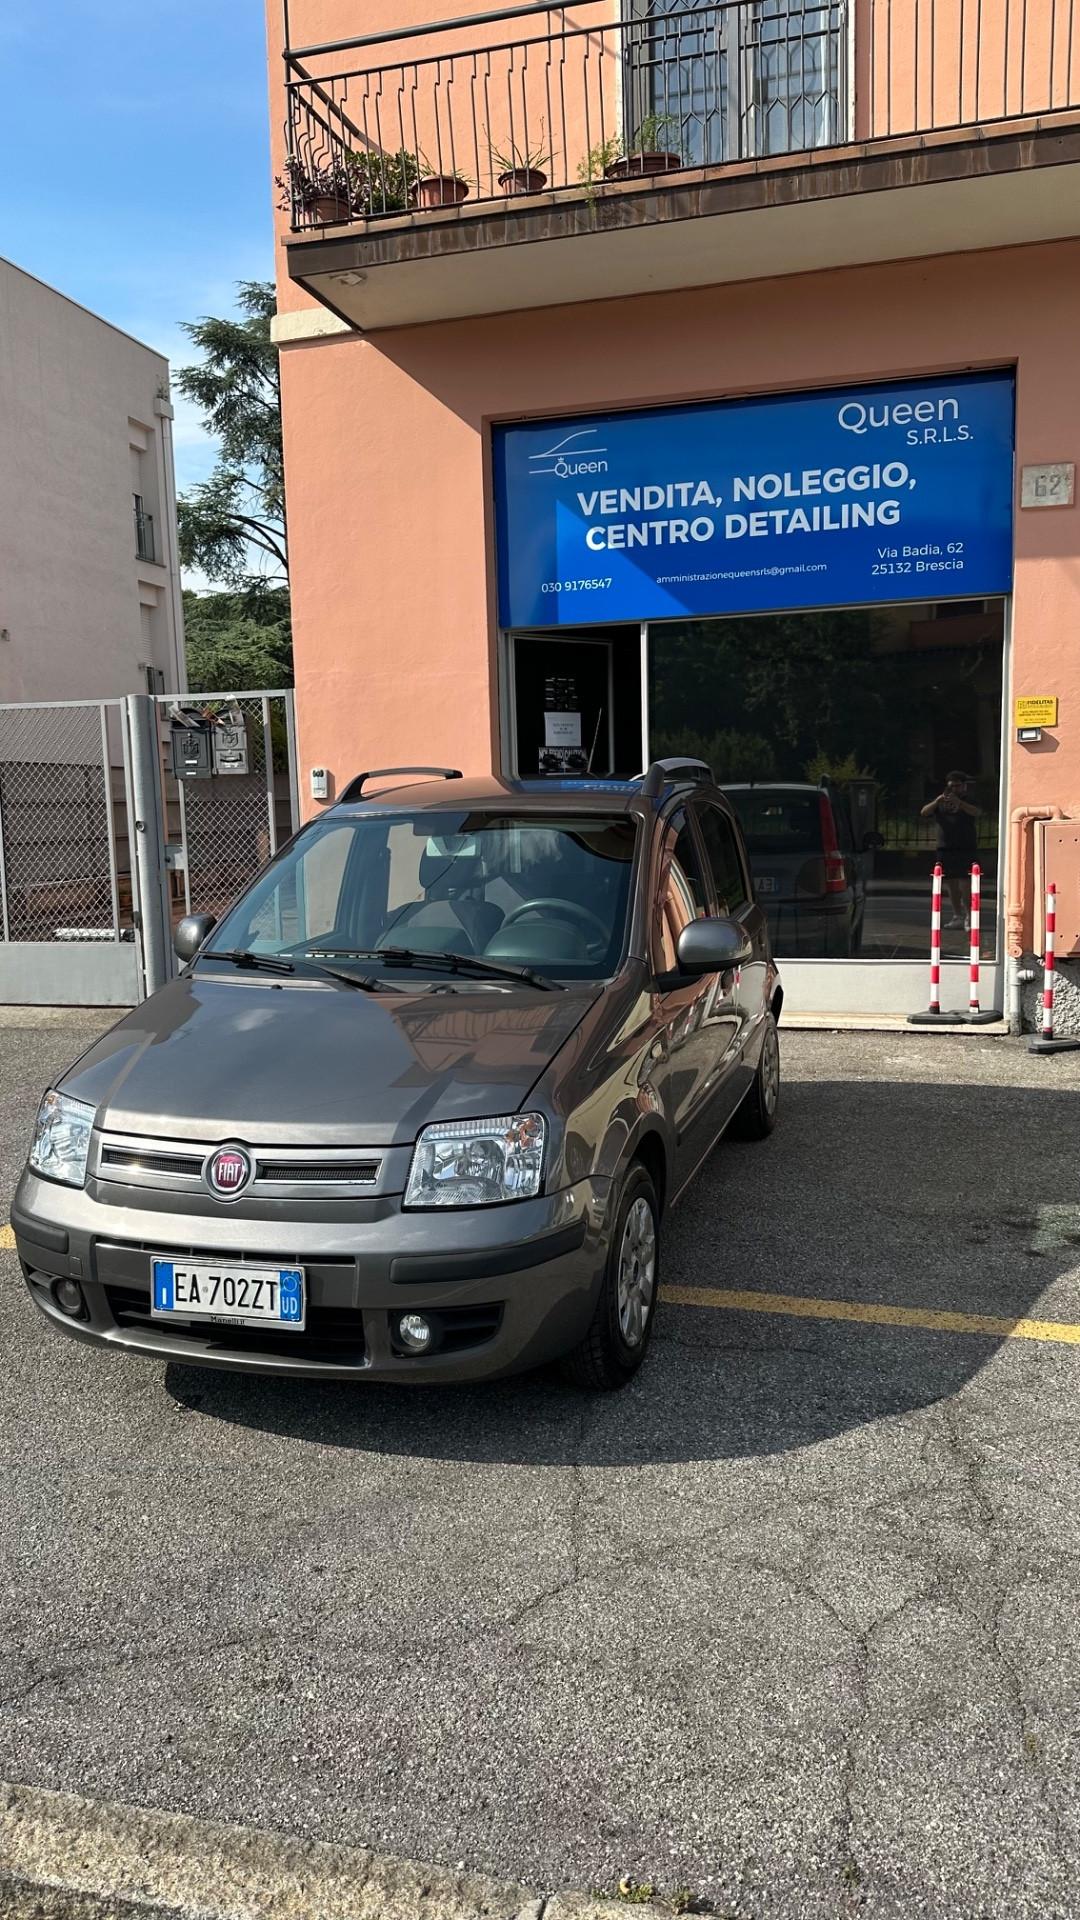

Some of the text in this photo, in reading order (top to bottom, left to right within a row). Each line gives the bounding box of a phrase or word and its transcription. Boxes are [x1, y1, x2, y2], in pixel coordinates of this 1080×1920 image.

[838, 399, 959, 434] Queen
[906, 424, 974, 446] S.R.L.S.
[554, 460, 608, 479] Queen
[577, 461, 916, 516] VENDITA, NOLEGGIO,
[585, 500, 901, 551] CENTRO DETAILING
[877, 542, 964, 558] Via Badia, 62
[656, 562, 827, 583] amministrazionequeensrls@gmail.com
[871, 558, 964, 575] 25132 Brescia
[541, 578, 612, 593] 030 9176547
[217, 1162, 241, 1182] FIAT
[281, 1296, 298, 1315] UD
